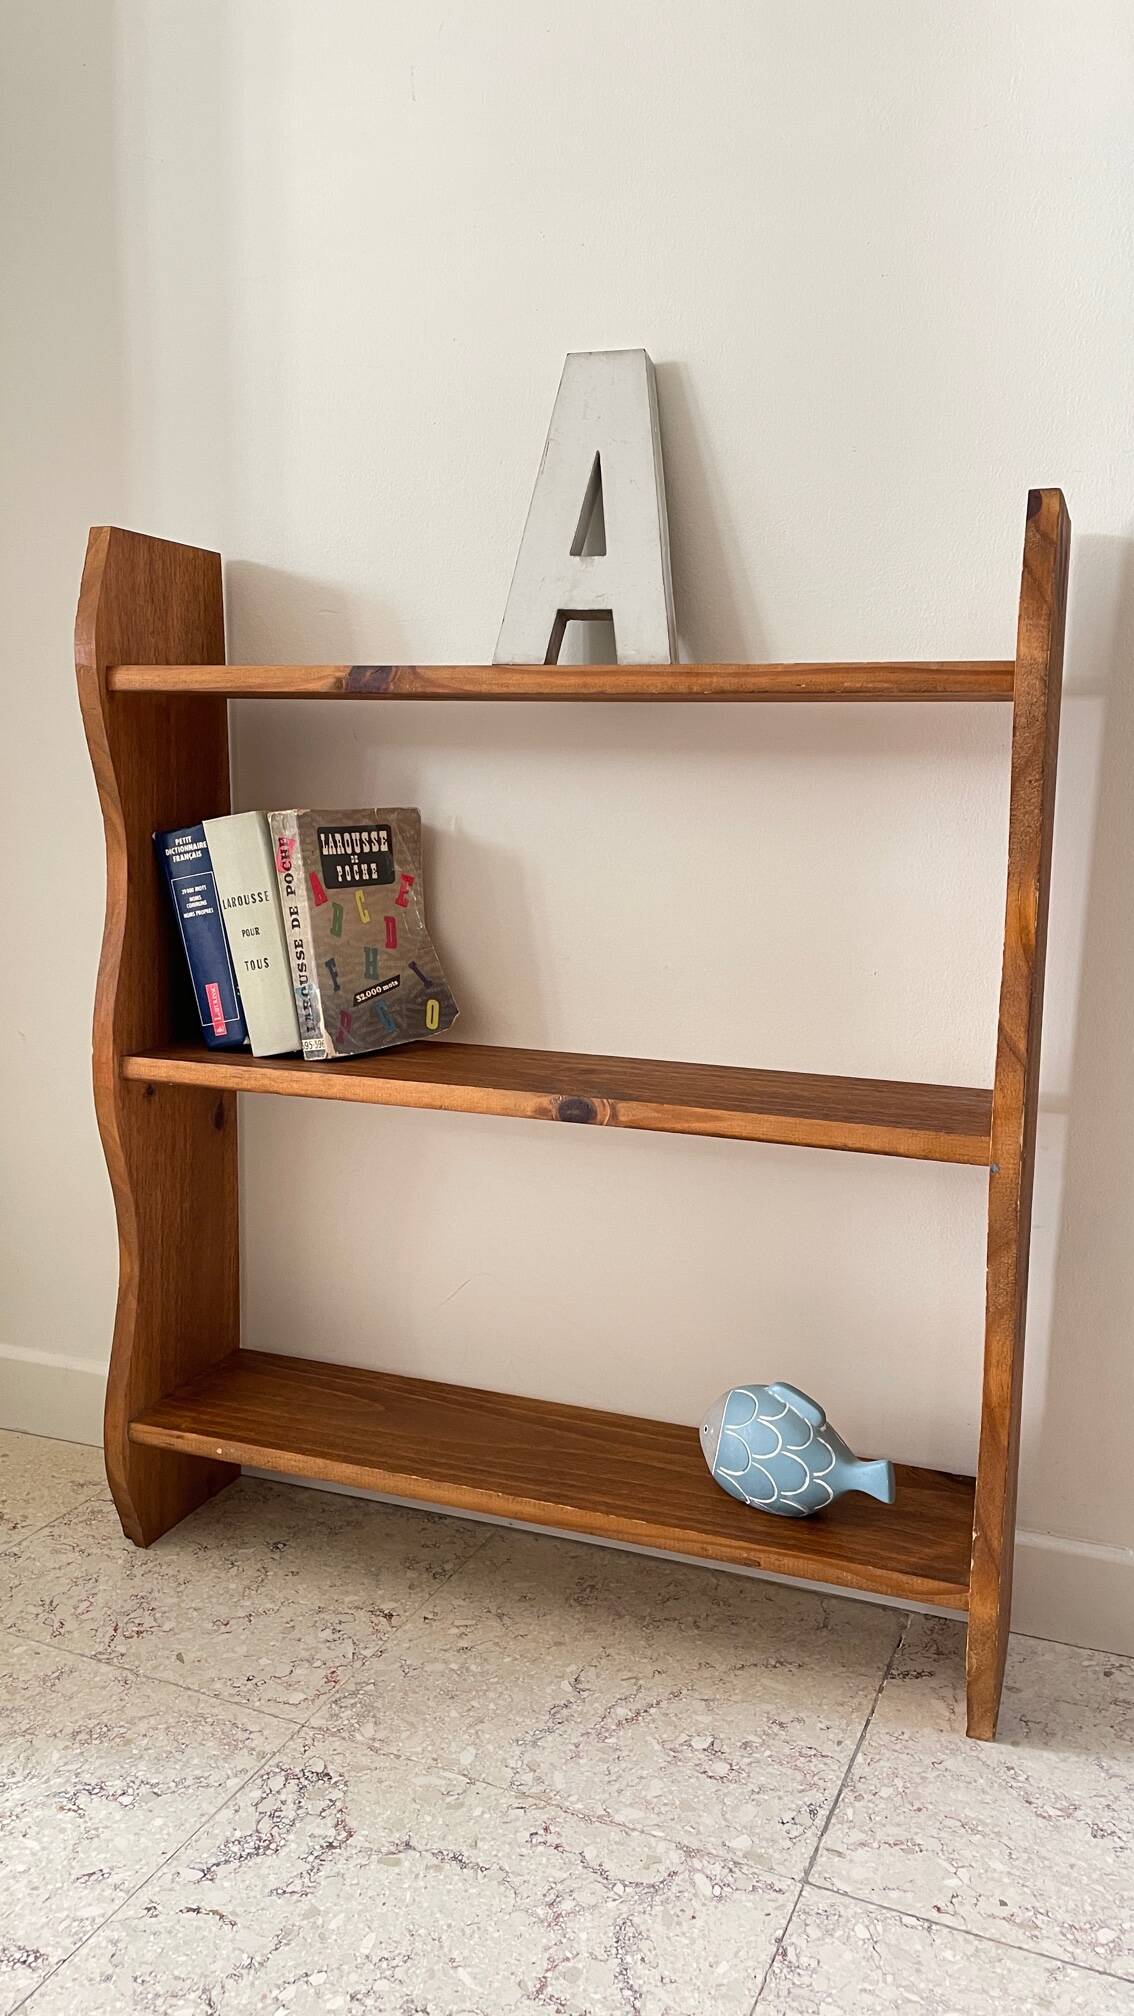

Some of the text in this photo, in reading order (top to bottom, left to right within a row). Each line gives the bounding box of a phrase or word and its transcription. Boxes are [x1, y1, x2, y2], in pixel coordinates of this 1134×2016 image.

[492, 348, 678, 665] A
[165, 840, 207, 856] DICTIONNAIRE
[175, 835, 192, 846] PETIT
[320, 830, 388, 855] LAROUSSE
[173, 850, 202, 863] FRANÇAIS
[278, 837, 296, 897] POCHE
[336, 863, 378, 882] POCHE
[222, 891, 270, 910] LAROUSSE
[289, 906, 301, 929] DE
[242, 927, 260, 938] POUR
[244, 957, 270, 971] TOUS
[382, 980, 399, 991] mots
